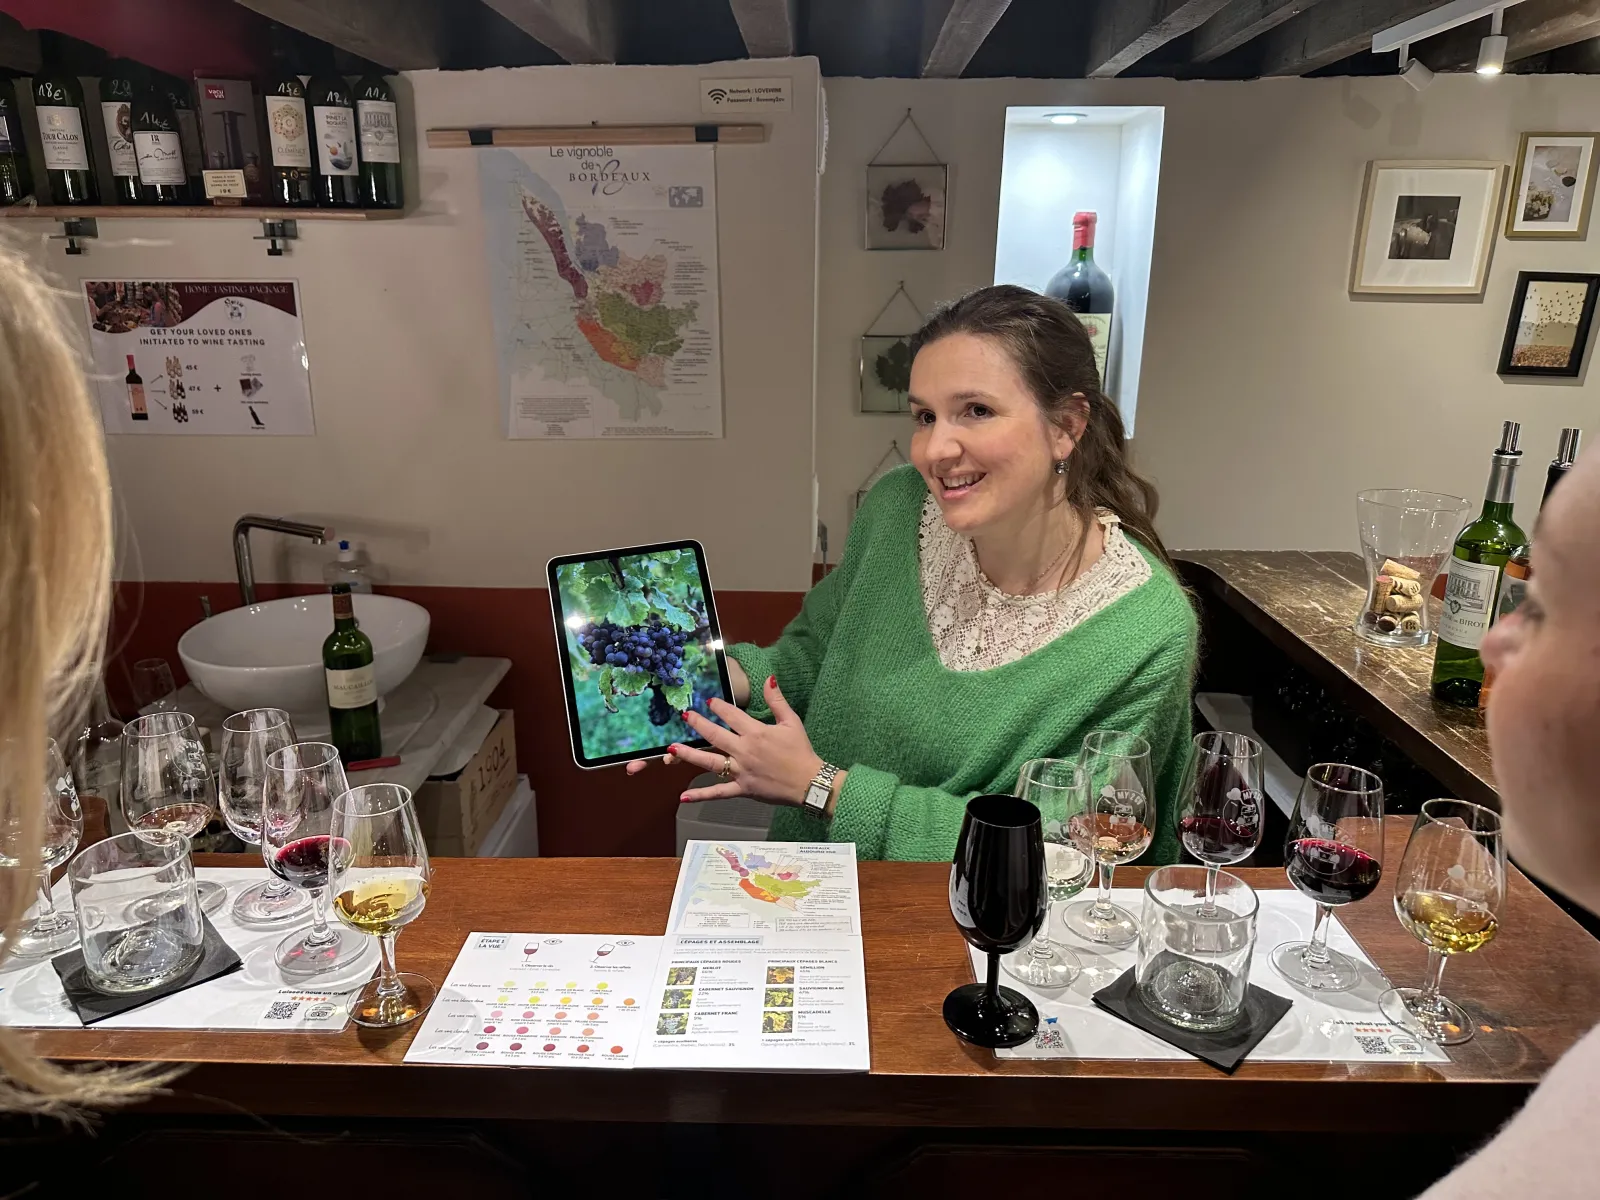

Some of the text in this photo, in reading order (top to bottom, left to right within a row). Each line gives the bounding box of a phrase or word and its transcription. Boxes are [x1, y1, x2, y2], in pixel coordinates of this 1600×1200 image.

[42, 132, 79, 141] TOUR CALON
[550, 146, 613, 160] Le vignoble
[581, 160, 594, 170] de
[569, 172, 650, 182] BORDEAUX
[184, 285, 288, 294] HOME TASTING PACKAGE
[150, 328, 252, 336] GET YOUR LOVED ONES
[140, 338, 266, 346] INITIATED TO WINE TASTING
[1459, 618, 1486, 629] BIROT
[1117, 791, 1130, 800] MY
